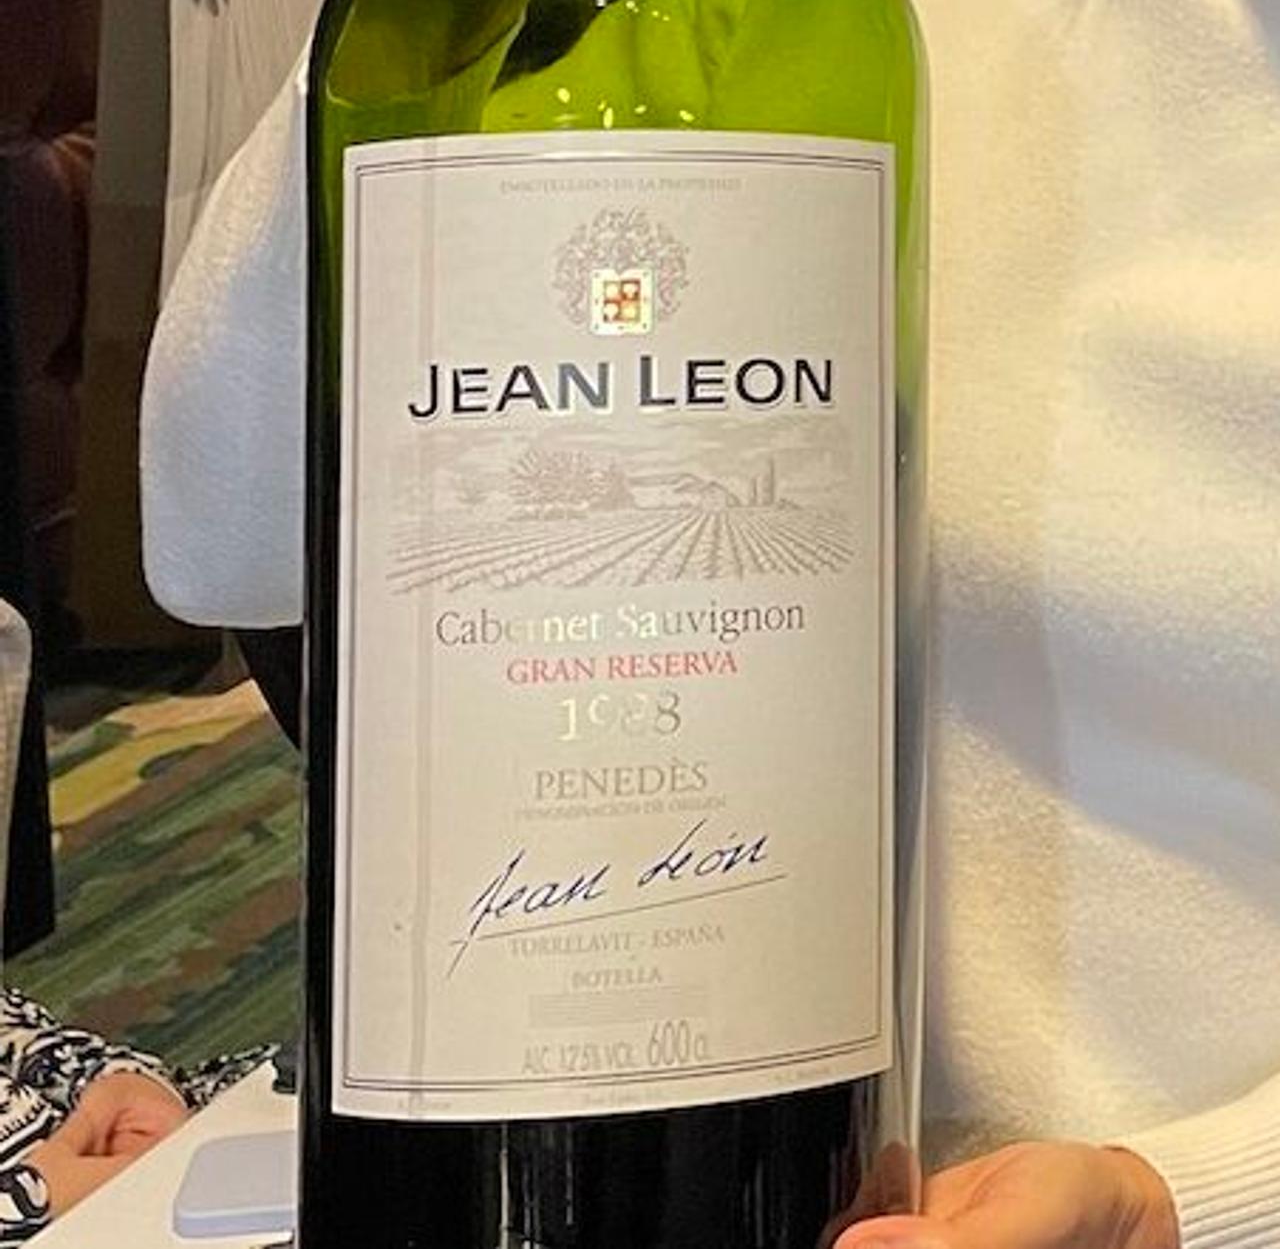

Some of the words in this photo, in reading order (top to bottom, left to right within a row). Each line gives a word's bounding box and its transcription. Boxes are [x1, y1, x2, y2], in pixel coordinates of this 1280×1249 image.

[408, 361, 611, 419] JEAN
[638, 354, 834, 408] LEON
[435, 609, 603, 646] Cabernet
[615, 601, 806, 644] Sauvignon
[506, 657, 596, 685] GRAN
[607, 650, 739, 680] RESERVA
[535, 756, 708, 800] PENEDÈS
[648, 1019, 690, 1067] 600
